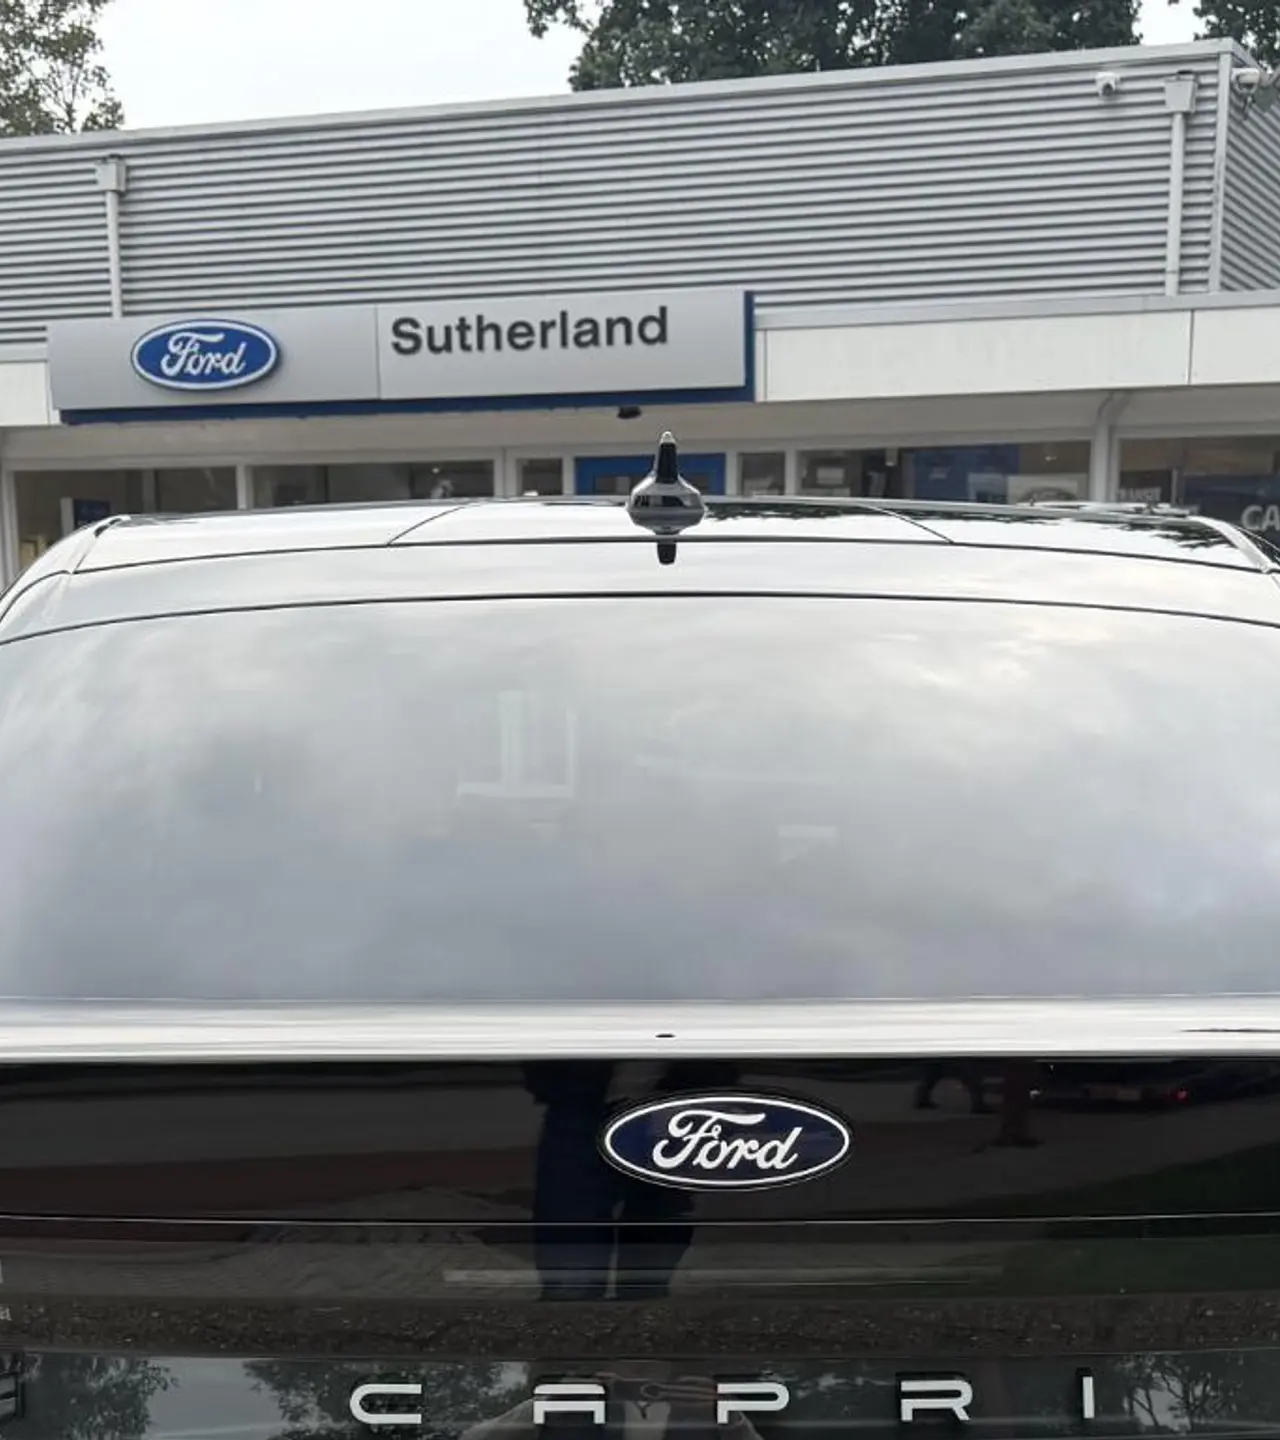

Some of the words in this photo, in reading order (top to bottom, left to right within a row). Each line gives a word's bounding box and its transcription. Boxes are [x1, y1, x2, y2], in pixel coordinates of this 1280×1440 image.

[160, 331, 248, 377] Ford
[390, 305, 668, 356] Sutherland
[652, 1109, 803, 1170] Ford
[349, 1376, 1095, 1425] CAPRI
